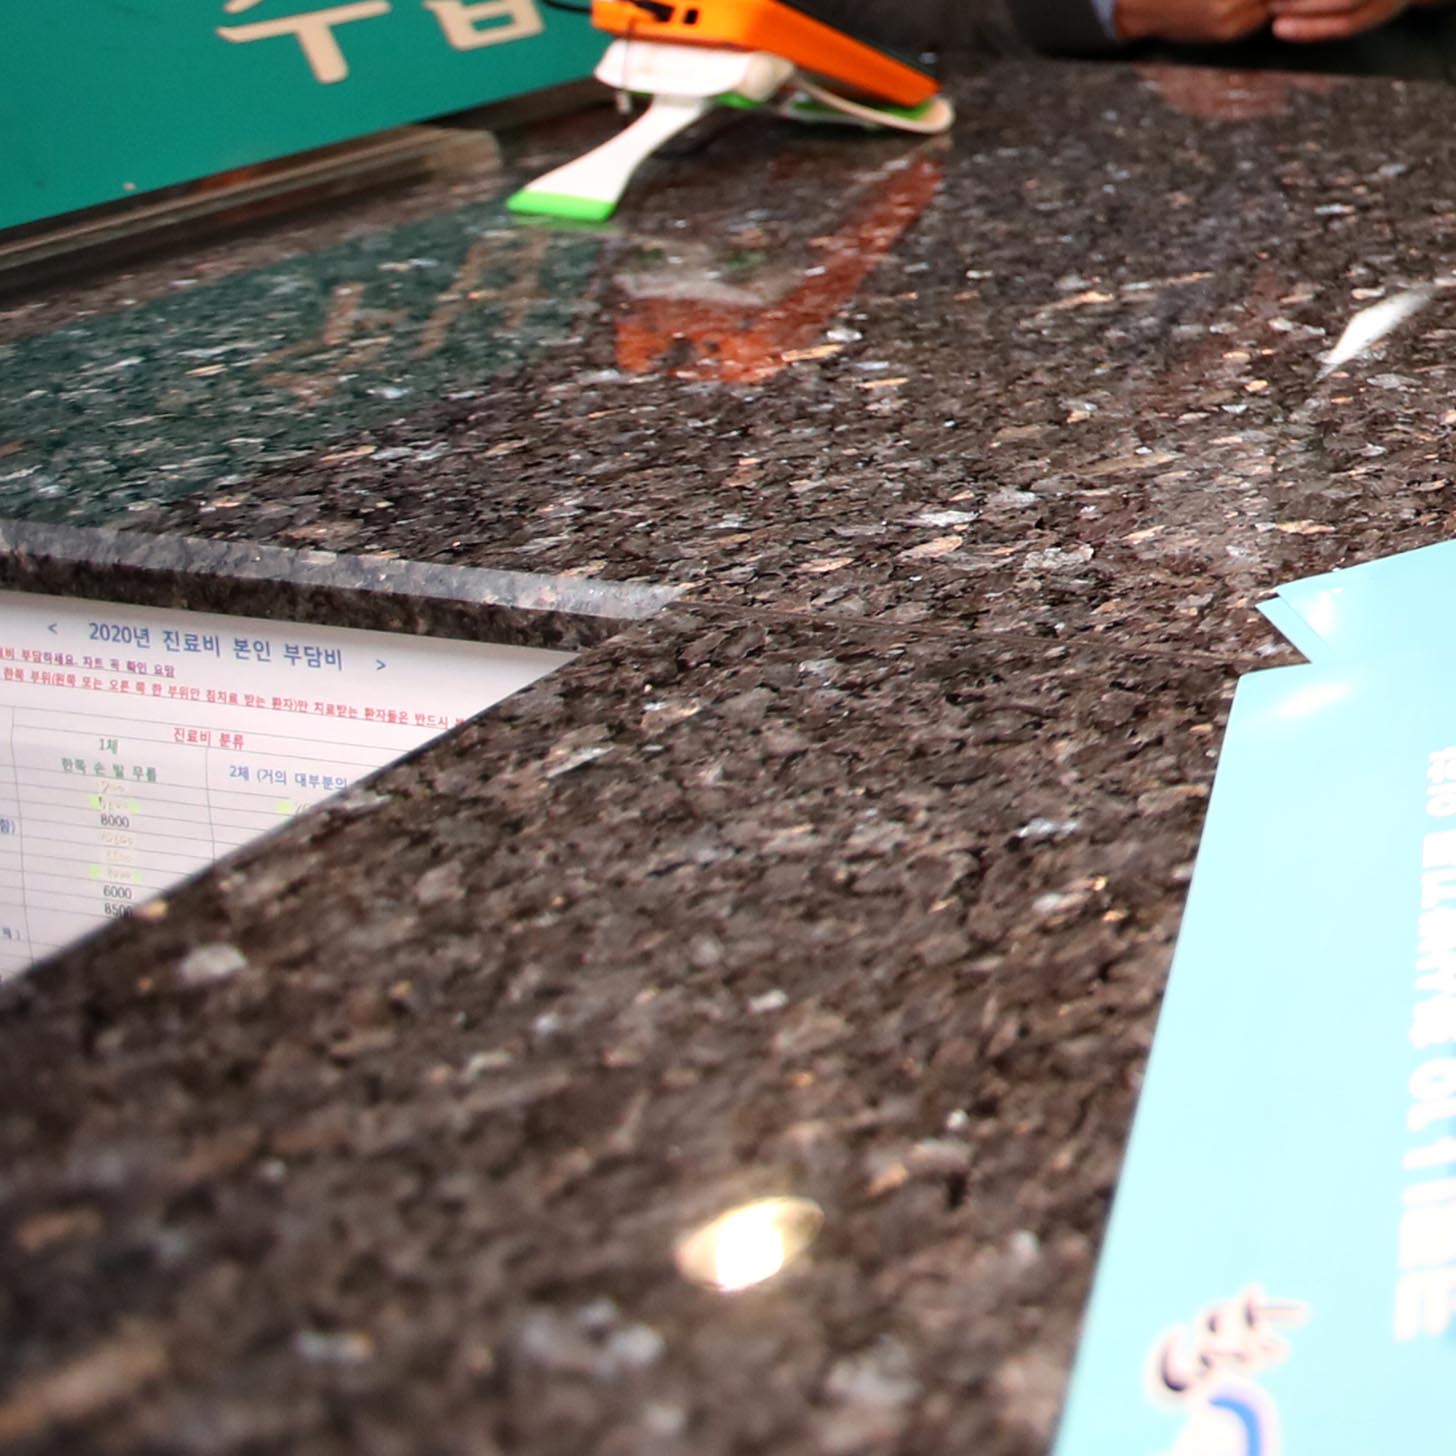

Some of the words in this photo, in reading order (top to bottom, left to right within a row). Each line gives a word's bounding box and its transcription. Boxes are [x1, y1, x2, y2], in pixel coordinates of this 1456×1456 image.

[89, 622, 151, 649] 2020년
[162, 630, 221, 657] 진료비
[233, 636, 271, 662] 본인
[284, 641, 343, 672] 부담비
[173, 727, 211, 746] 진료비
[219, 733, 244, 750] 분류
[256, 768, 287, 787] (거의
[100, 814, 130, 828] 8000
[103, 885, 132, 900] 6000
